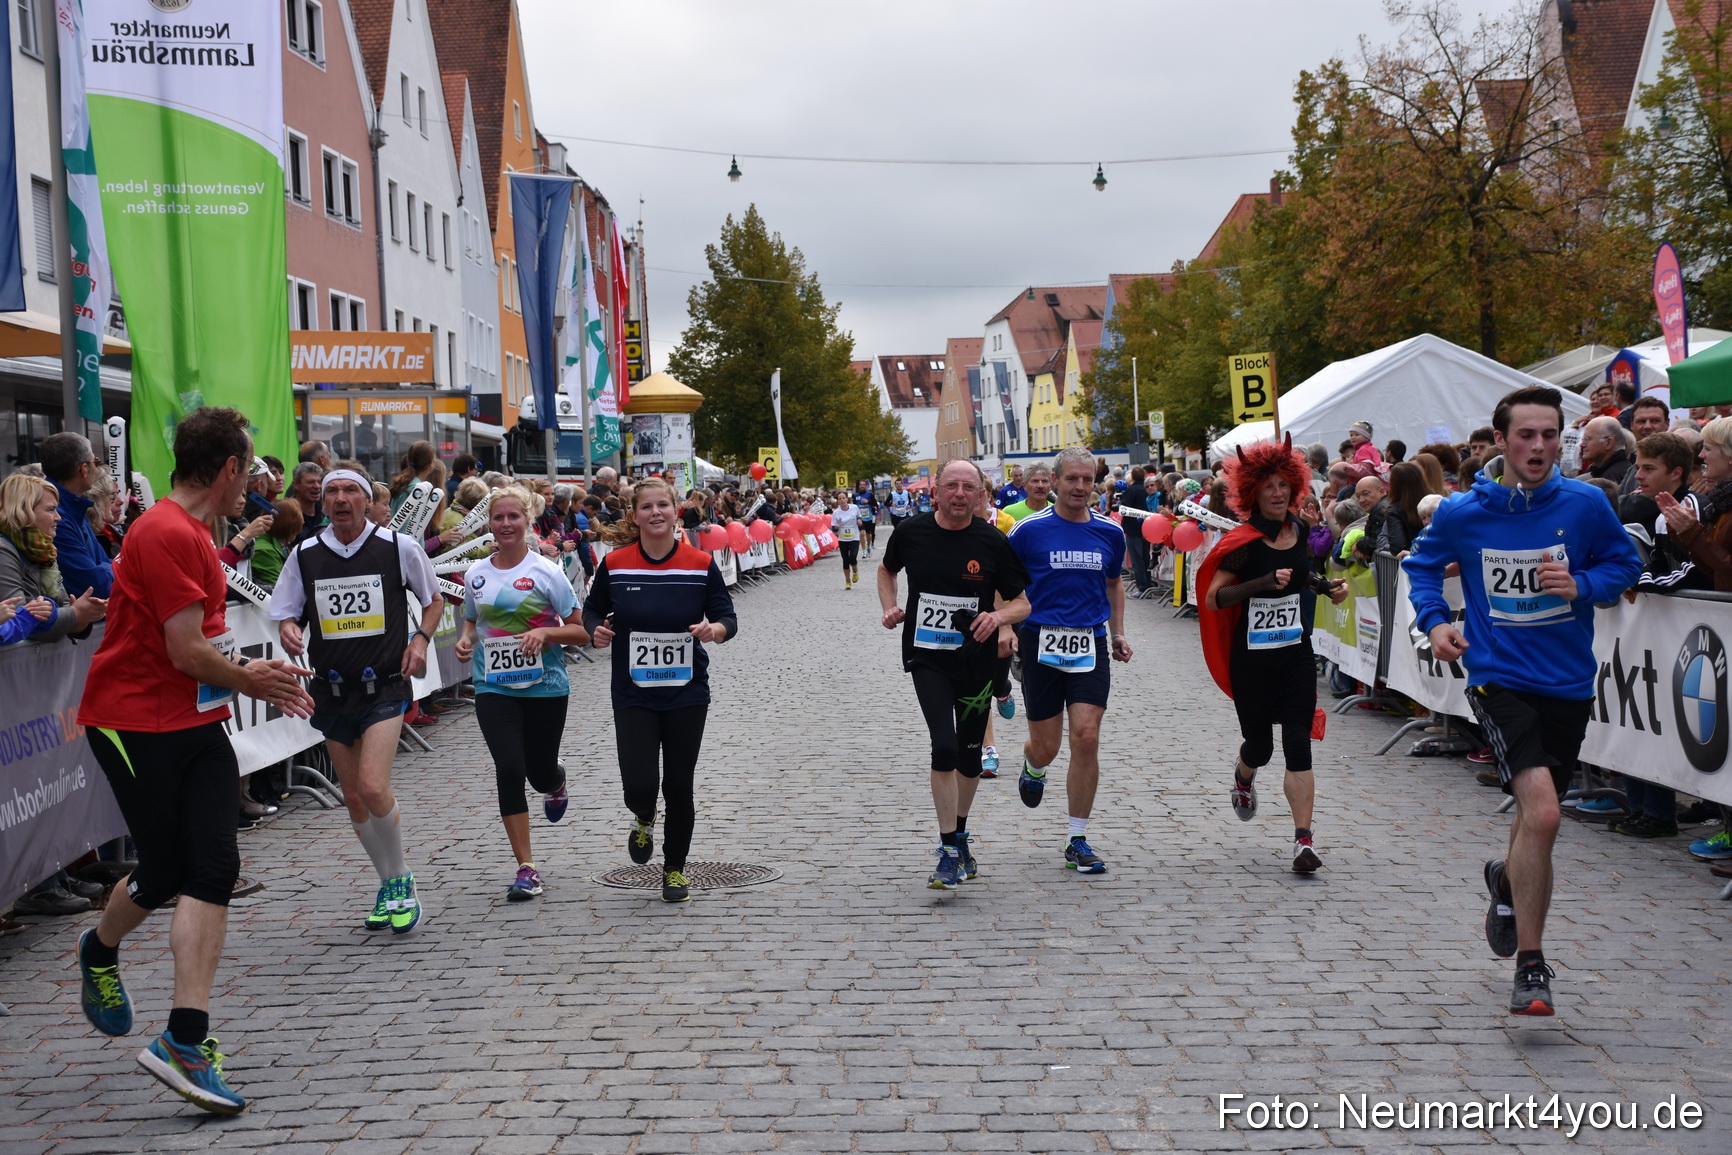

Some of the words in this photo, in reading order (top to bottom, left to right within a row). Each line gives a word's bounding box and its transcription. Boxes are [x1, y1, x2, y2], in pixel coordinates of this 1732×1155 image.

[1235, 356, 1270, 370] Block
[1243, 375, 1267, 408] B
[764, 457, 775, 473] C
[839, 477, 846, 485] D
[1050, 551, 1102, 563] HUBER
[1484, 555, 1511, 564] PARTL
[1512, 555, 1554, 565] Neumat
[338, 582, 370, 590] Neumarkt
[328, 591, 371, 616] 323
[920, 597, 939, 606] PARTL
[1270, 600, 1294, 608] Neumarkt
[1516, 601, 1539, 611] Max
[1253, 607, 1297, 630] 2257
[337, 620, 365, 631] Lothar
[935, 634, 955, 643] Hans
[1045, 633, 1090, 654] 2469
[636, 645, 685, 665] 2161
[1059, 657, 1075, 666] Uwe
[496, 672, 533, 683] Katharina
[646, 670, 676, 679] Claudia
[0, 713, 60, 766] NDUSTRY
